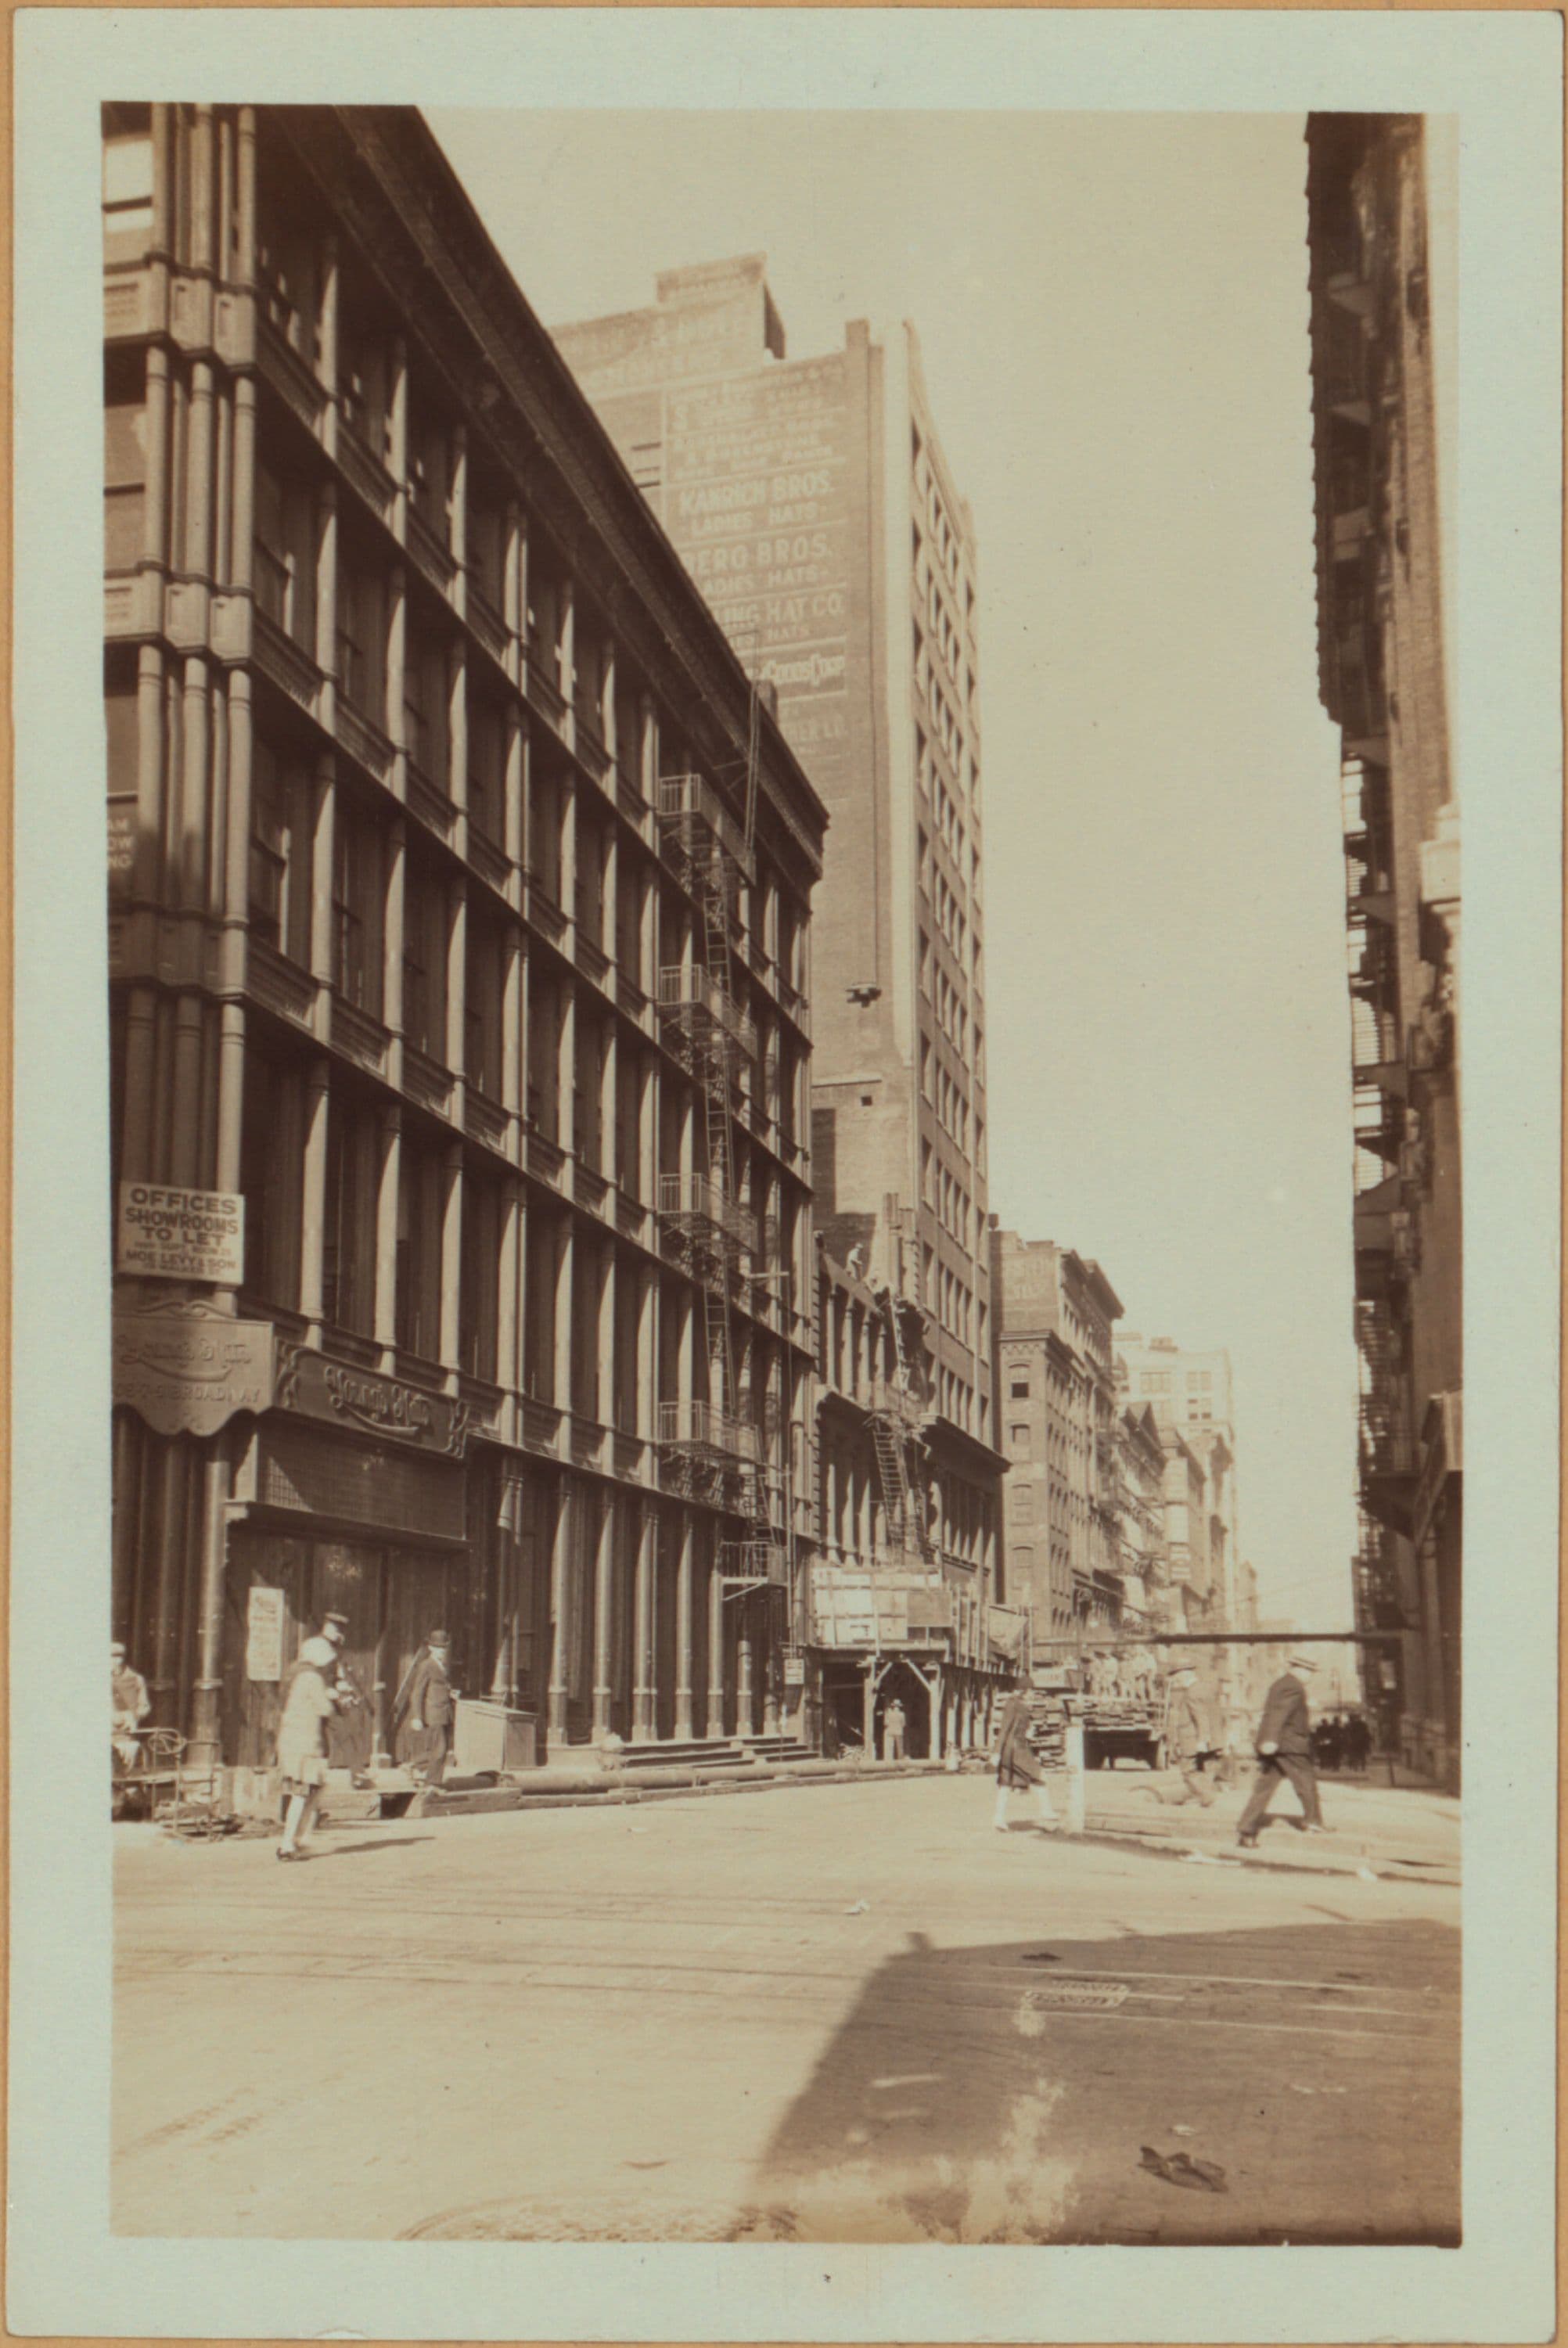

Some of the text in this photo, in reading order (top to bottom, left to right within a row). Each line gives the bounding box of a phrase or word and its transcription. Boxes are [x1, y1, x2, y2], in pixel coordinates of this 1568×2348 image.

[130, 1188, 237, 1215] OFFICES
[125, 1206, 238, 1235] SHOWROOMS
[139, 1225, 225, 1246] TO LET
